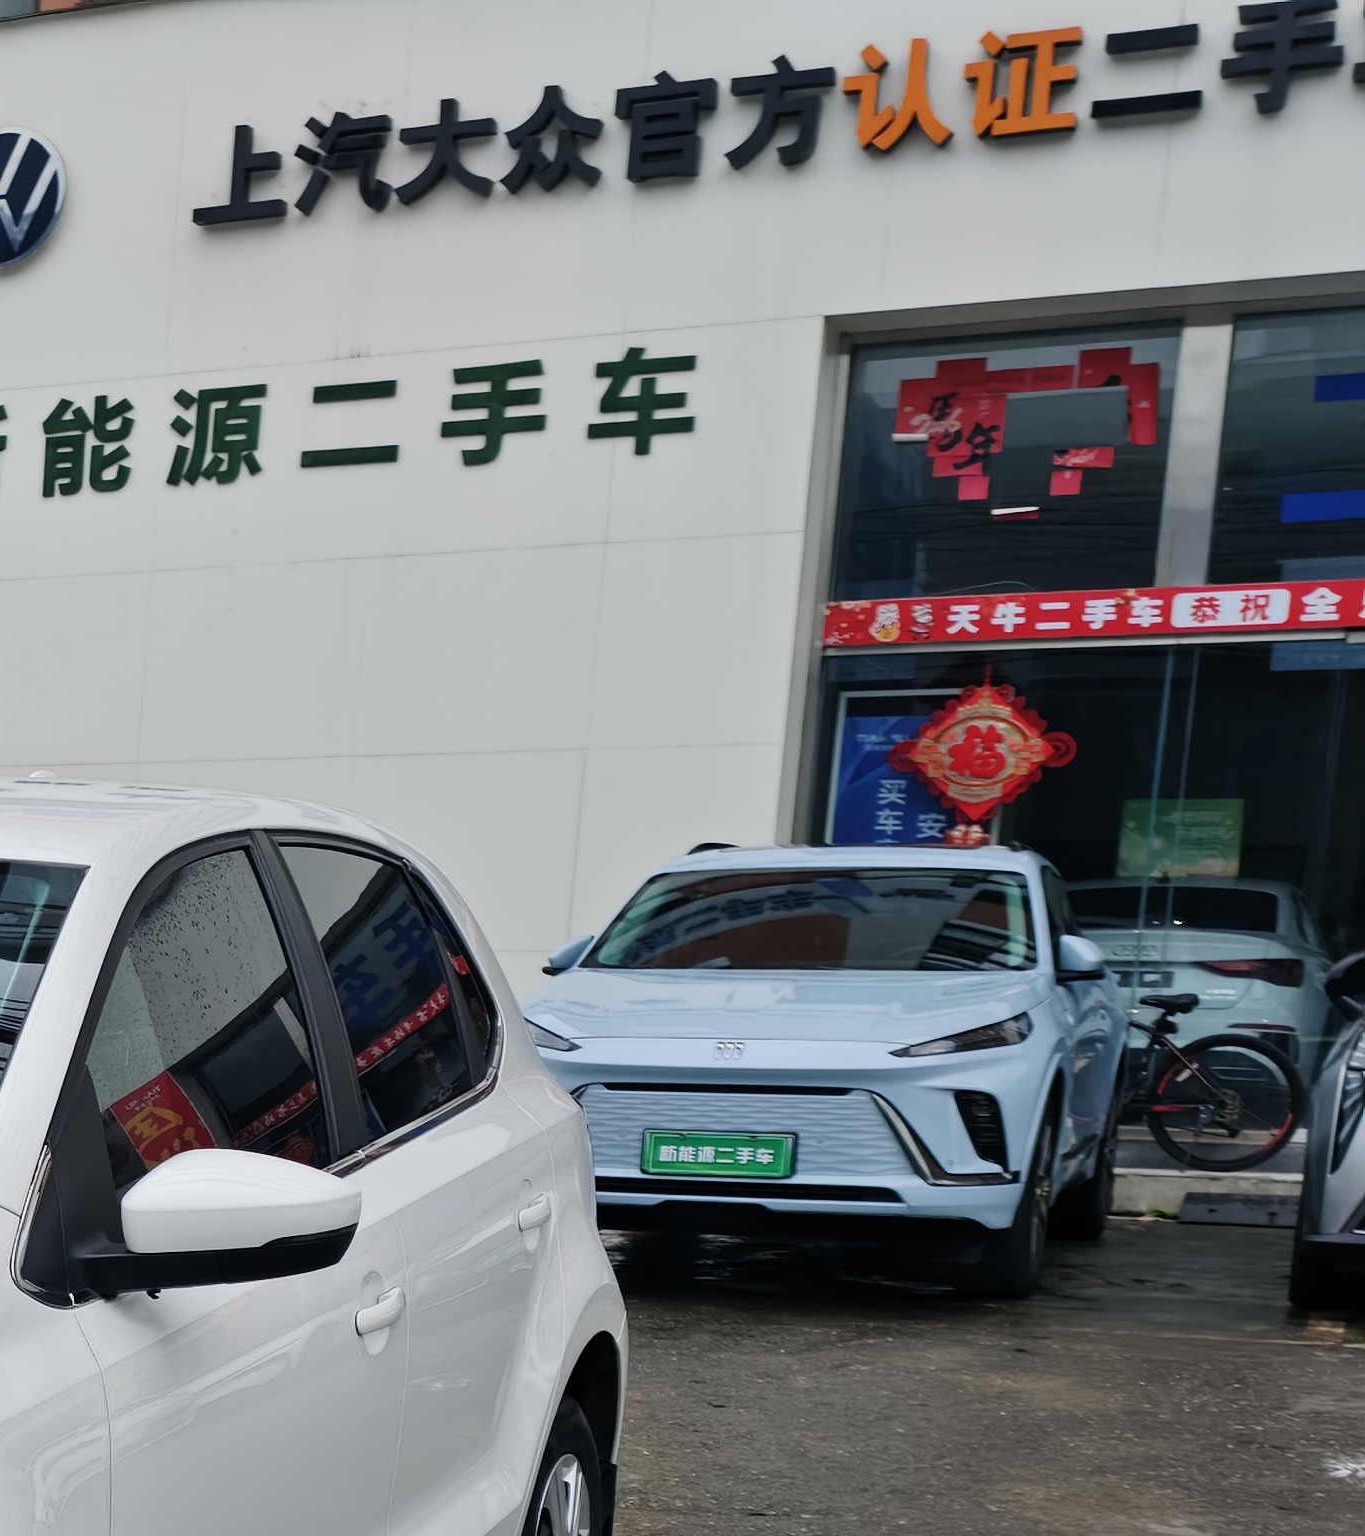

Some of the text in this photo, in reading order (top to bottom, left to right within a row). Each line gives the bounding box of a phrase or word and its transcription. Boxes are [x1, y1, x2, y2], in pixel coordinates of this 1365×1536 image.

[192, 0, 1365, 227] 上汽大众官方认证二手
[873, 779, 907, 844] 买车
[658, 1144, 775, 1165] 新能源二手车
